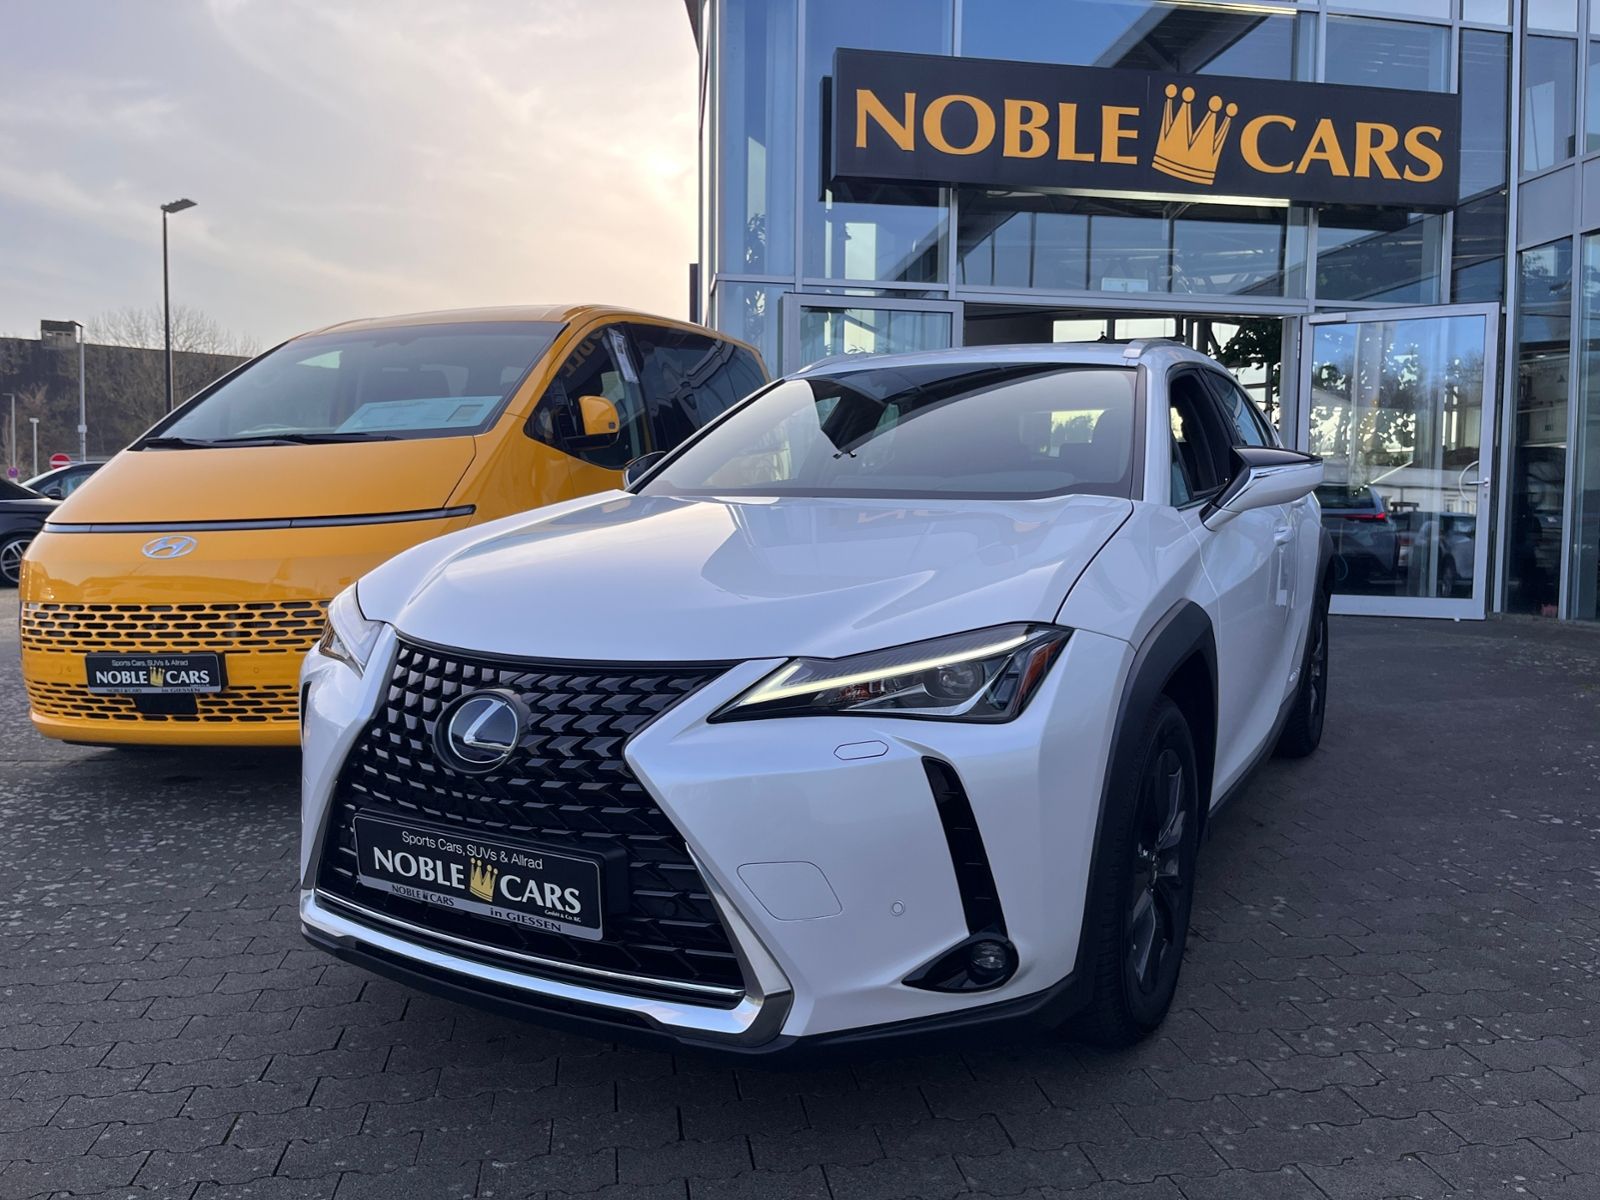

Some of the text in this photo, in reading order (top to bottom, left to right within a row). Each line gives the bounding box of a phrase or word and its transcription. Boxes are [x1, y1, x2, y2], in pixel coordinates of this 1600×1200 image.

[855, 88, 1444, 182] NOBLE CARS
[95, 670, 210, 684] NOBLE CARS
[401, 830, 543, 870] Sports Cars, SUVs & Allrad
[373, 846, 582, 914] NOBLE CARS
[391, 884, 455, 907] NOBLE CARS
[490, 907, 562, 933] in GIESSEN
